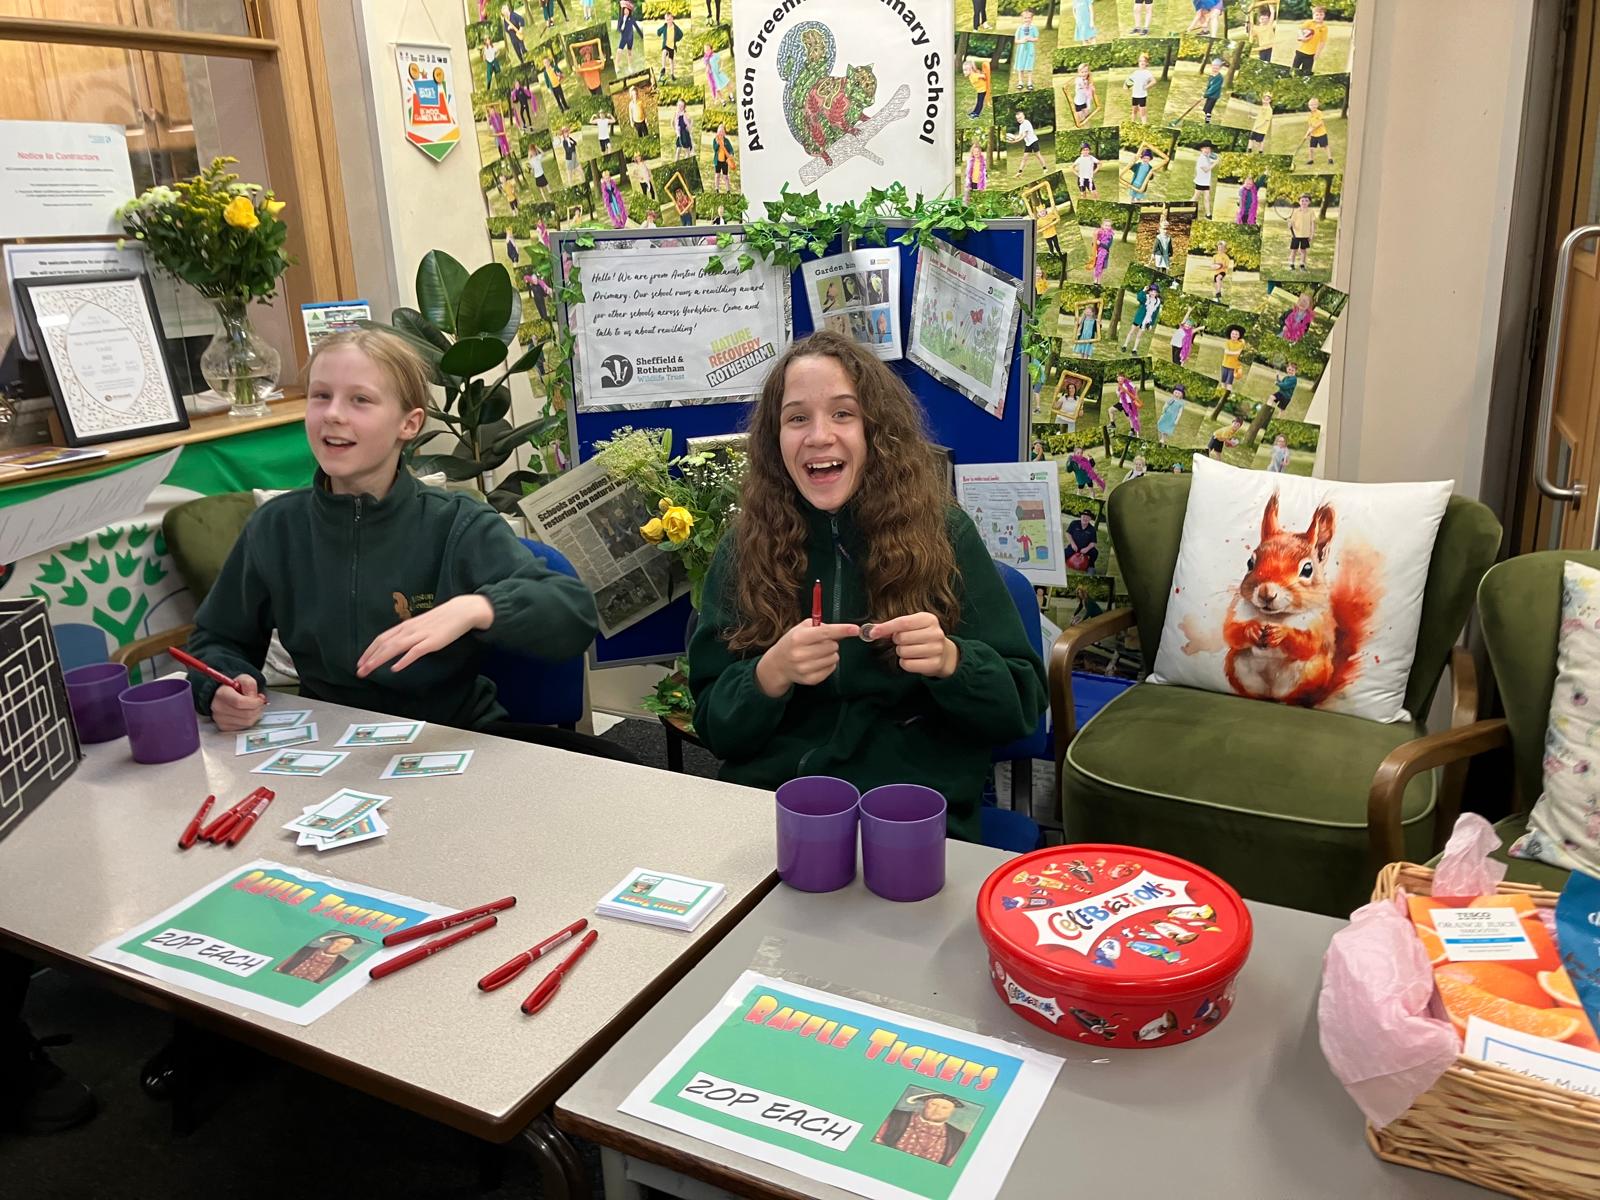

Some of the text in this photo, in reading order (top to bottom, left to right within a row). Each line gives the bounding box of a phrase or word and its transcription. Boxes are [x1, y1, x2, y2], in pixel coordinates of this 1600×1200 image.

[741, 0, 944, 152] Anston Green mary School
[17, 152, 100, 161] Notice to Contractors
[592, 272, 616, 283] Hello!
[618, 272, 633, 283] We
[649, 272, 668, 284] from
[671, 269, 697, 280] Anston
[815, 264, 844, 276] Garden
[592, 291, 631, 304] Primary.
[633, 289, 649, 300] Our
[651, 288, 673, 299] school
[674, 288, 692, 298] runs
[701, 284, 737, 297] rewilding
[739, 283, 765, 292] award
[593, 311, 606, 324] for
[607, 309, 627, 319] other
[630, 307, 655, 319] schools
[657, 308, 680, 317] across
[723, 303, 742, 313] Come
[744, 301, 760, 311] and
[596, 328, 613, 337] talk
[614, 328, 621, 336] to
[634, 326, 656, 335] about
[657, 323, 697, 336] rewilding!
[710, 327, 753, 353] NATURE
[636, 355, 684, 366] Sheffield &
[708, 337, 761, 368] RECOVERY
[637, 365, 685, 375] Rotherham
[708, 344, 775, 387] ROTHERHAM!
[637, 373, 685, 383] Wildlife Trust
[537, 500, 568, 522] Schools
[568, 494, 580, 506] are
[580, 477, 608, 498] leading
[543, 508, 577, 530] restoring
[577, 500, 590, 511] the
[590, 483, 616, 504] natural
[1438, 920, 1518, 929] ORANGE JUICE
[1456, 911, 1491, 920] TESCO
[150, 931, 265, 971] 20P EACH
[744, 994, 999, 1092] RAFFLE TICKETS
[685, 1079, 852, 1142] 20P EACH
